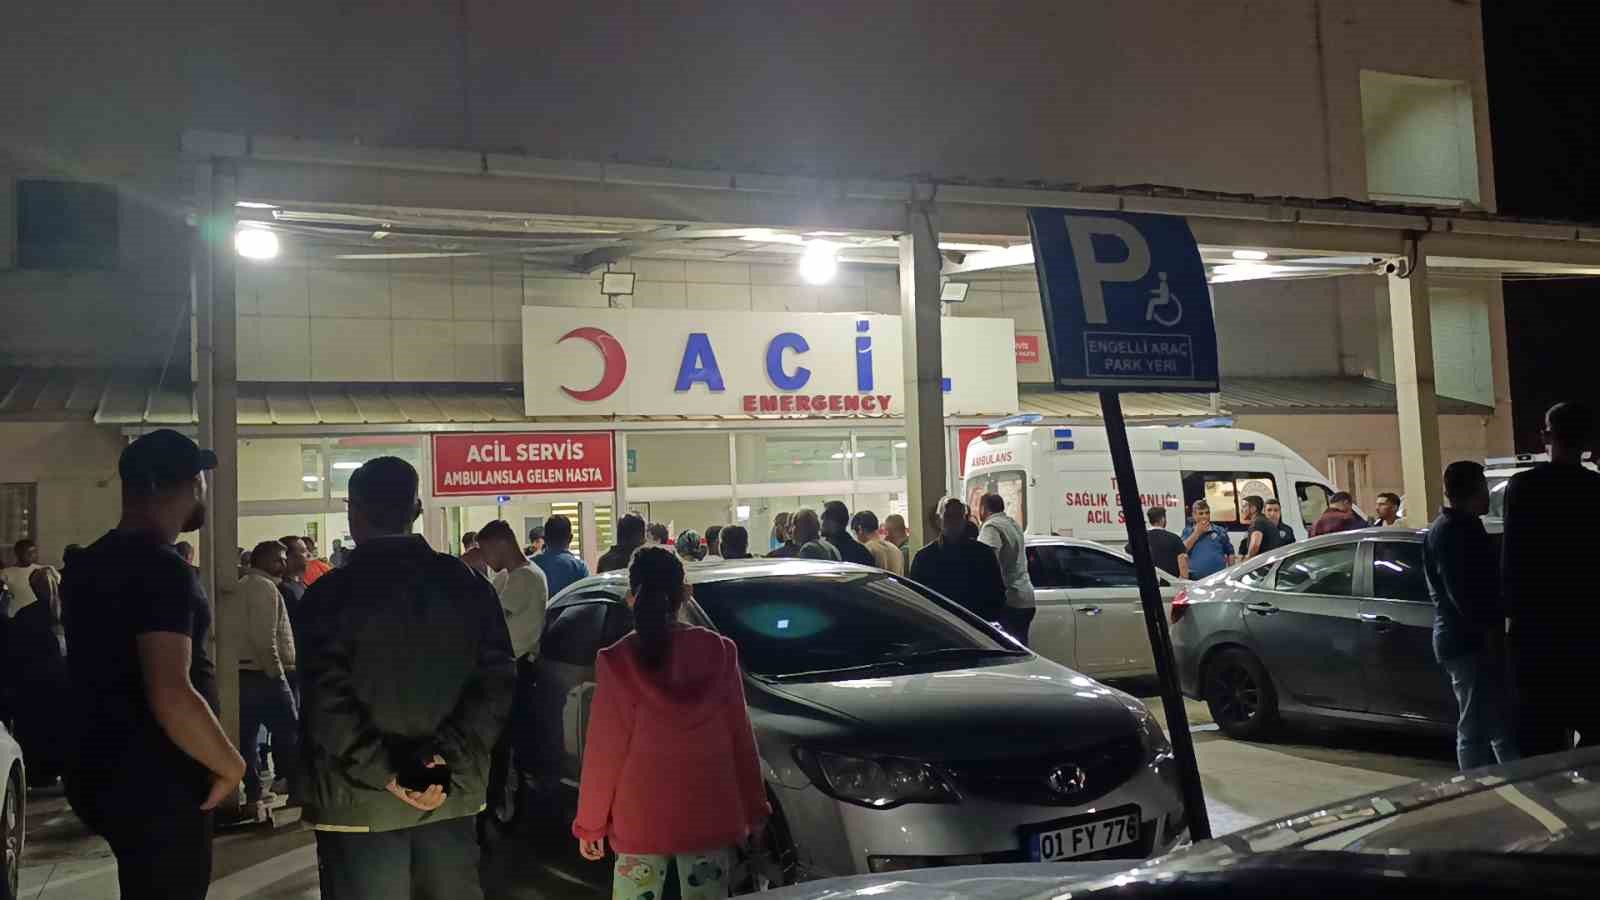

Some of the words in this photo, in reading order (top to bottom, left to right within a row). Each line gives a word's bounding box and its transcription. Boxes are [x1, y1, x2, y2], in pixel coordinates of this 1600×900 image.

[1064, 215, 1151, 324] P
[674, 320, 952, 391] ACİ
[1104, 357, 1142, 372] PARK
[743, 394, 893, 413] EMERGENCY
[466, 440, 511, 463] ACİL
[516, 438, 584, 462] SERVİS
[972, 451, 1013, 466] AMBULANS
[444, 469, 524, 487] AMBULANSLA
[527, 467, 563, 484] GELEN
[566, 467, 602, 482] HASTA
[1065, 490, 1109, 507] SAĞLIK
[1087, 508, 1113, 524] ACİL
[1041, 832, 1064, 859] 01
[1072, 825, 1097, 853] FY
[1103, 815, 1137, 846] 776
